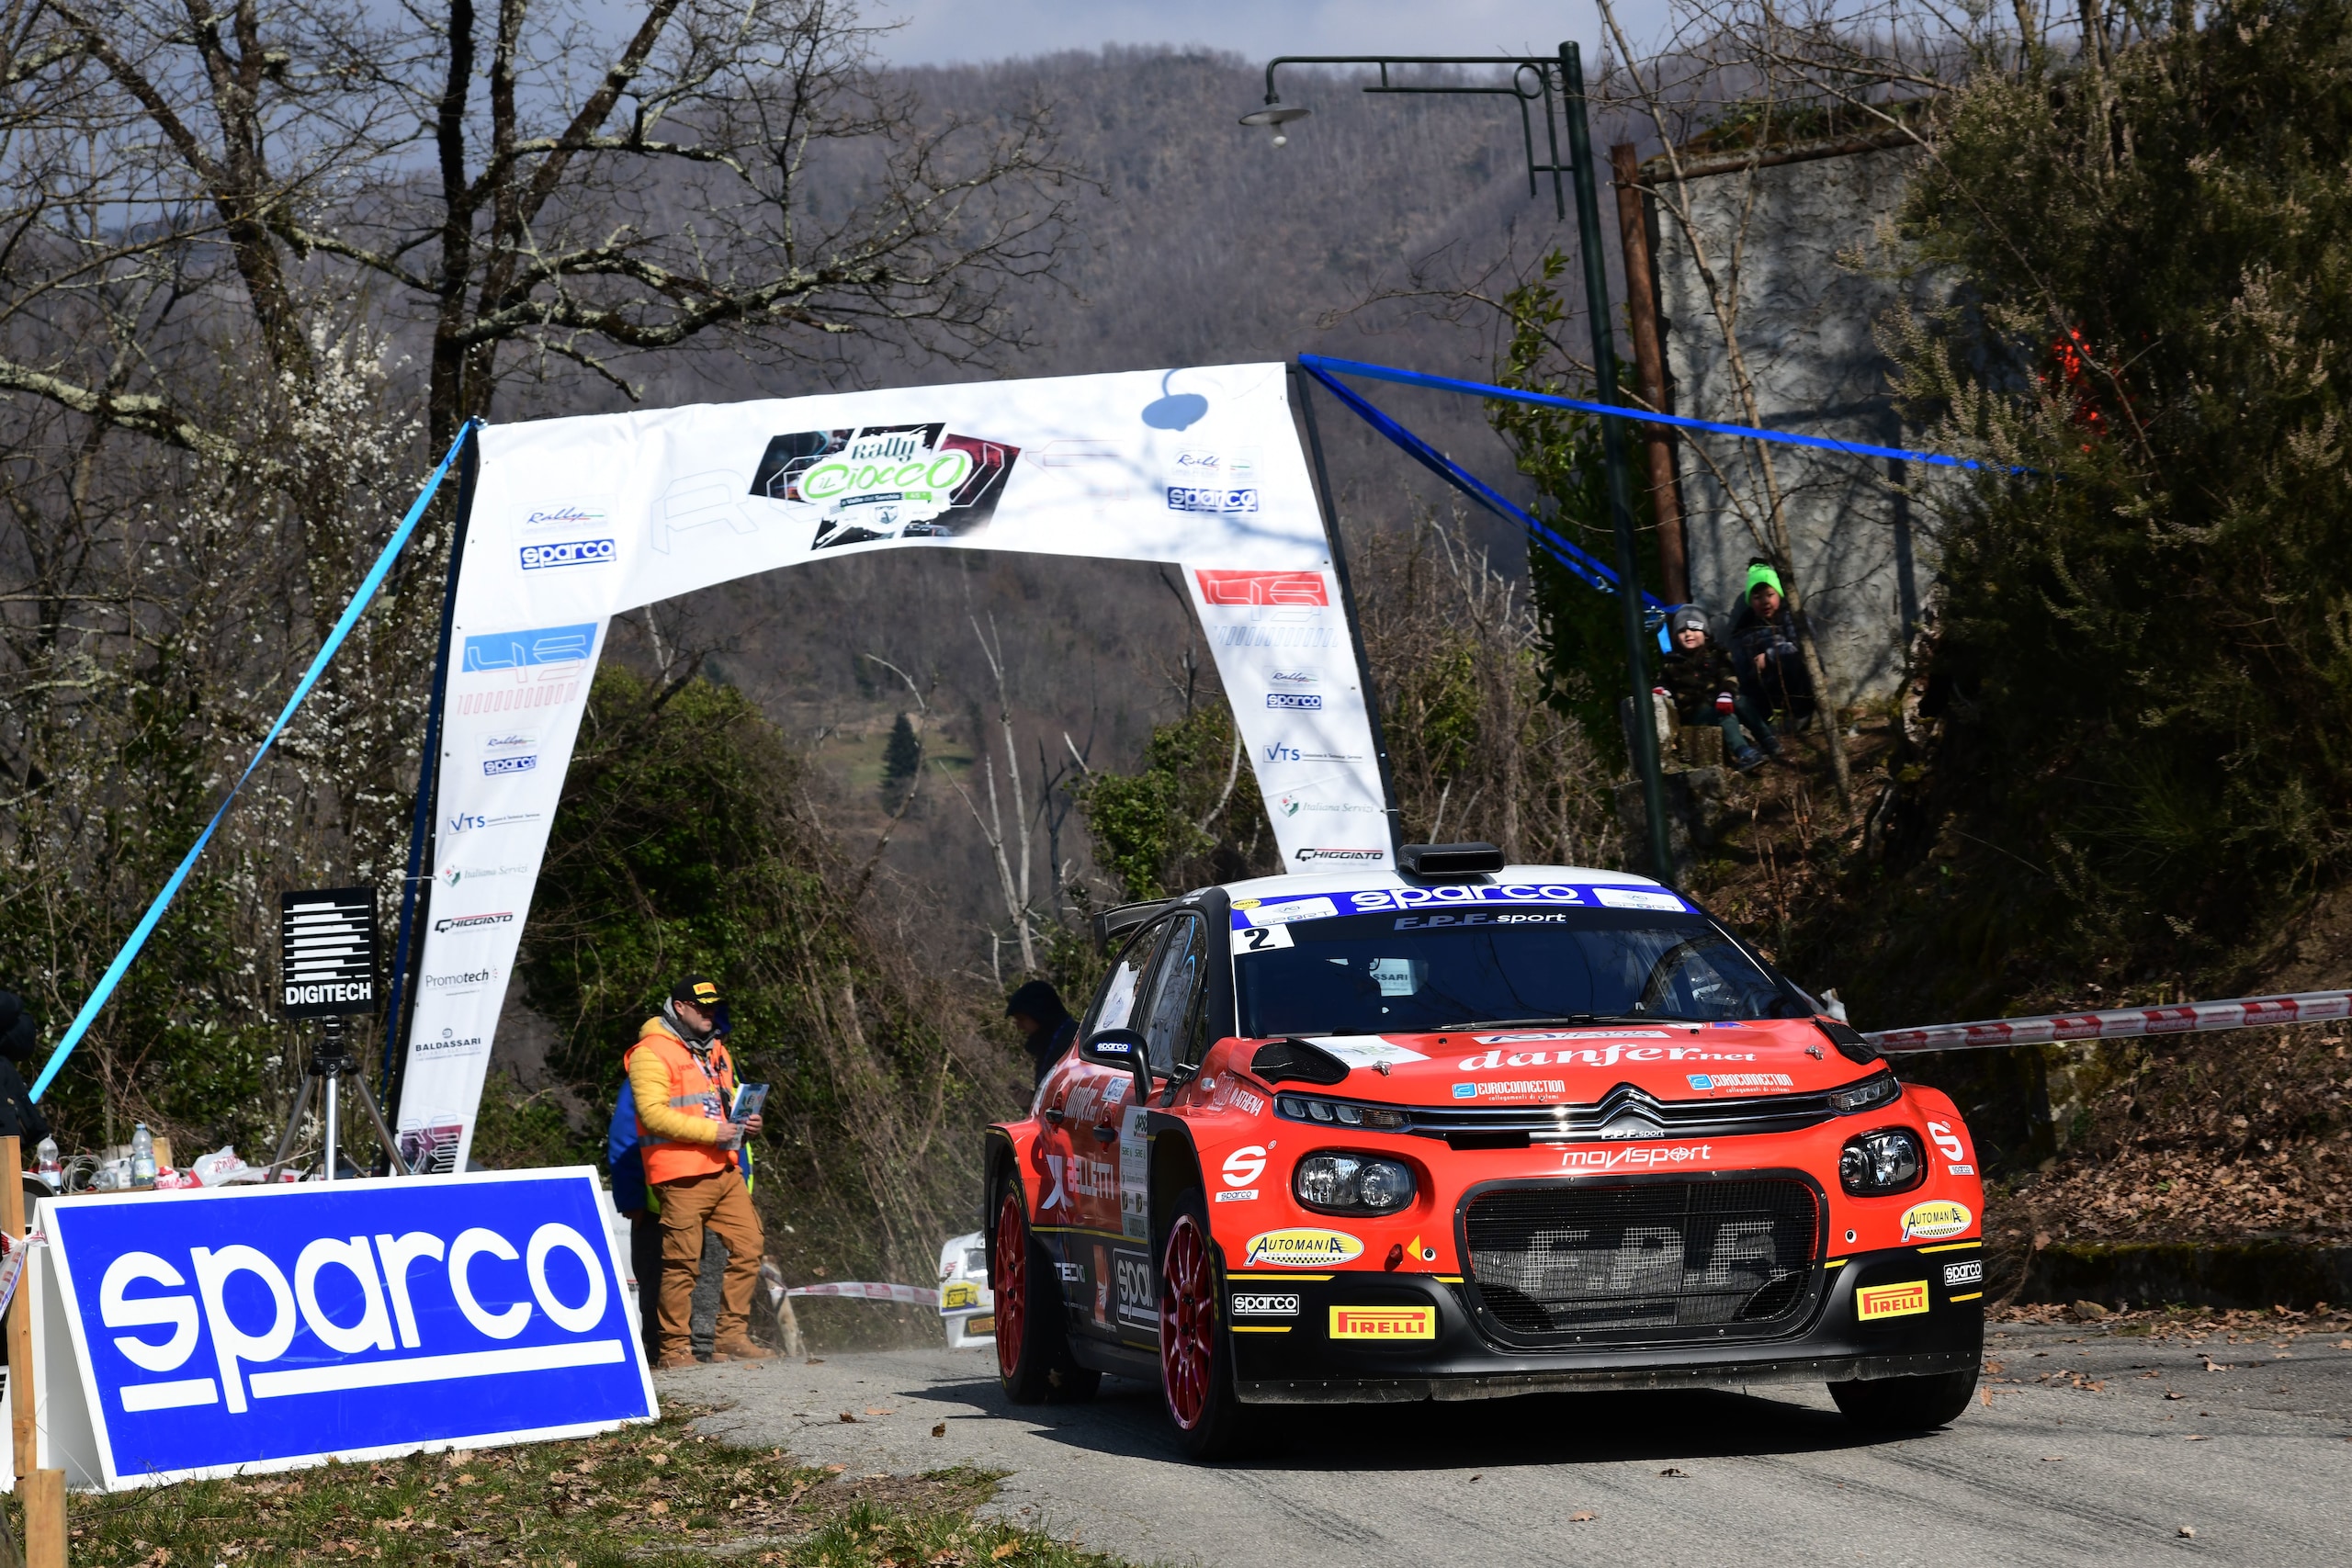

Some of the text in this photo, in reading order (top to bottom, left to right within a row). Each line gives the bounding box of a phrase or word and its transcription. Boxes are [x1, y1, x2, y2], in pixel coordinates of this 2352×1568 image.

[851, 436, 917, 463] Rally
[1170, 489, 1257, 511] sparco
[522, 540, 615, 568] sparco
[1268, 694, 1321, 709] sparco
[1267, 742, 1300, 761] VTS
[485, 757, 536, 774] sparco
[1303, 802, 1374, 814] Italiana Servizi
[451, 813, 485, 831] VTS
[465, 864, 528, 879] Italiana Servizi
[1351, 885, 1579, 909] sparco
[1497, 913, 1567, 924] sport
[1244, 928, 1275, 950] 2
[426, 968, 489, 987] Promotech
[285, 982, 372, 1005] DIGITECH
[415, 1038, 481, 1052] BALDASSARI
[1097, 1043, 1128, 1053] sparco
[1458, 1043, 1758, 1072] danfer.net
[1477, 1079, 1566, 1095] EUROCONNECTION
[1711, 1074, 1793, 1087] EUROCONNECTION
[1233, 1089, 1265, 1117] ATHENA
[1951, 1166, 1971, 1174] sparco
[1221, 1190, 1251, 1201] sparco
[1904, 1208, 1962, 1239] AUTOMANIA
[1249, 1236, 1345, 1263] AUTOMANIA
[1946, 1262, 1981, 1282] sparco
[1235, 1296, 1297, 1314] sparco
[1863, 1287, 1923, 1314] PIRELLI
[100, 1223, 607, 1415] sparco
[1339, 1312, 1426, 1333] PIRELLI
